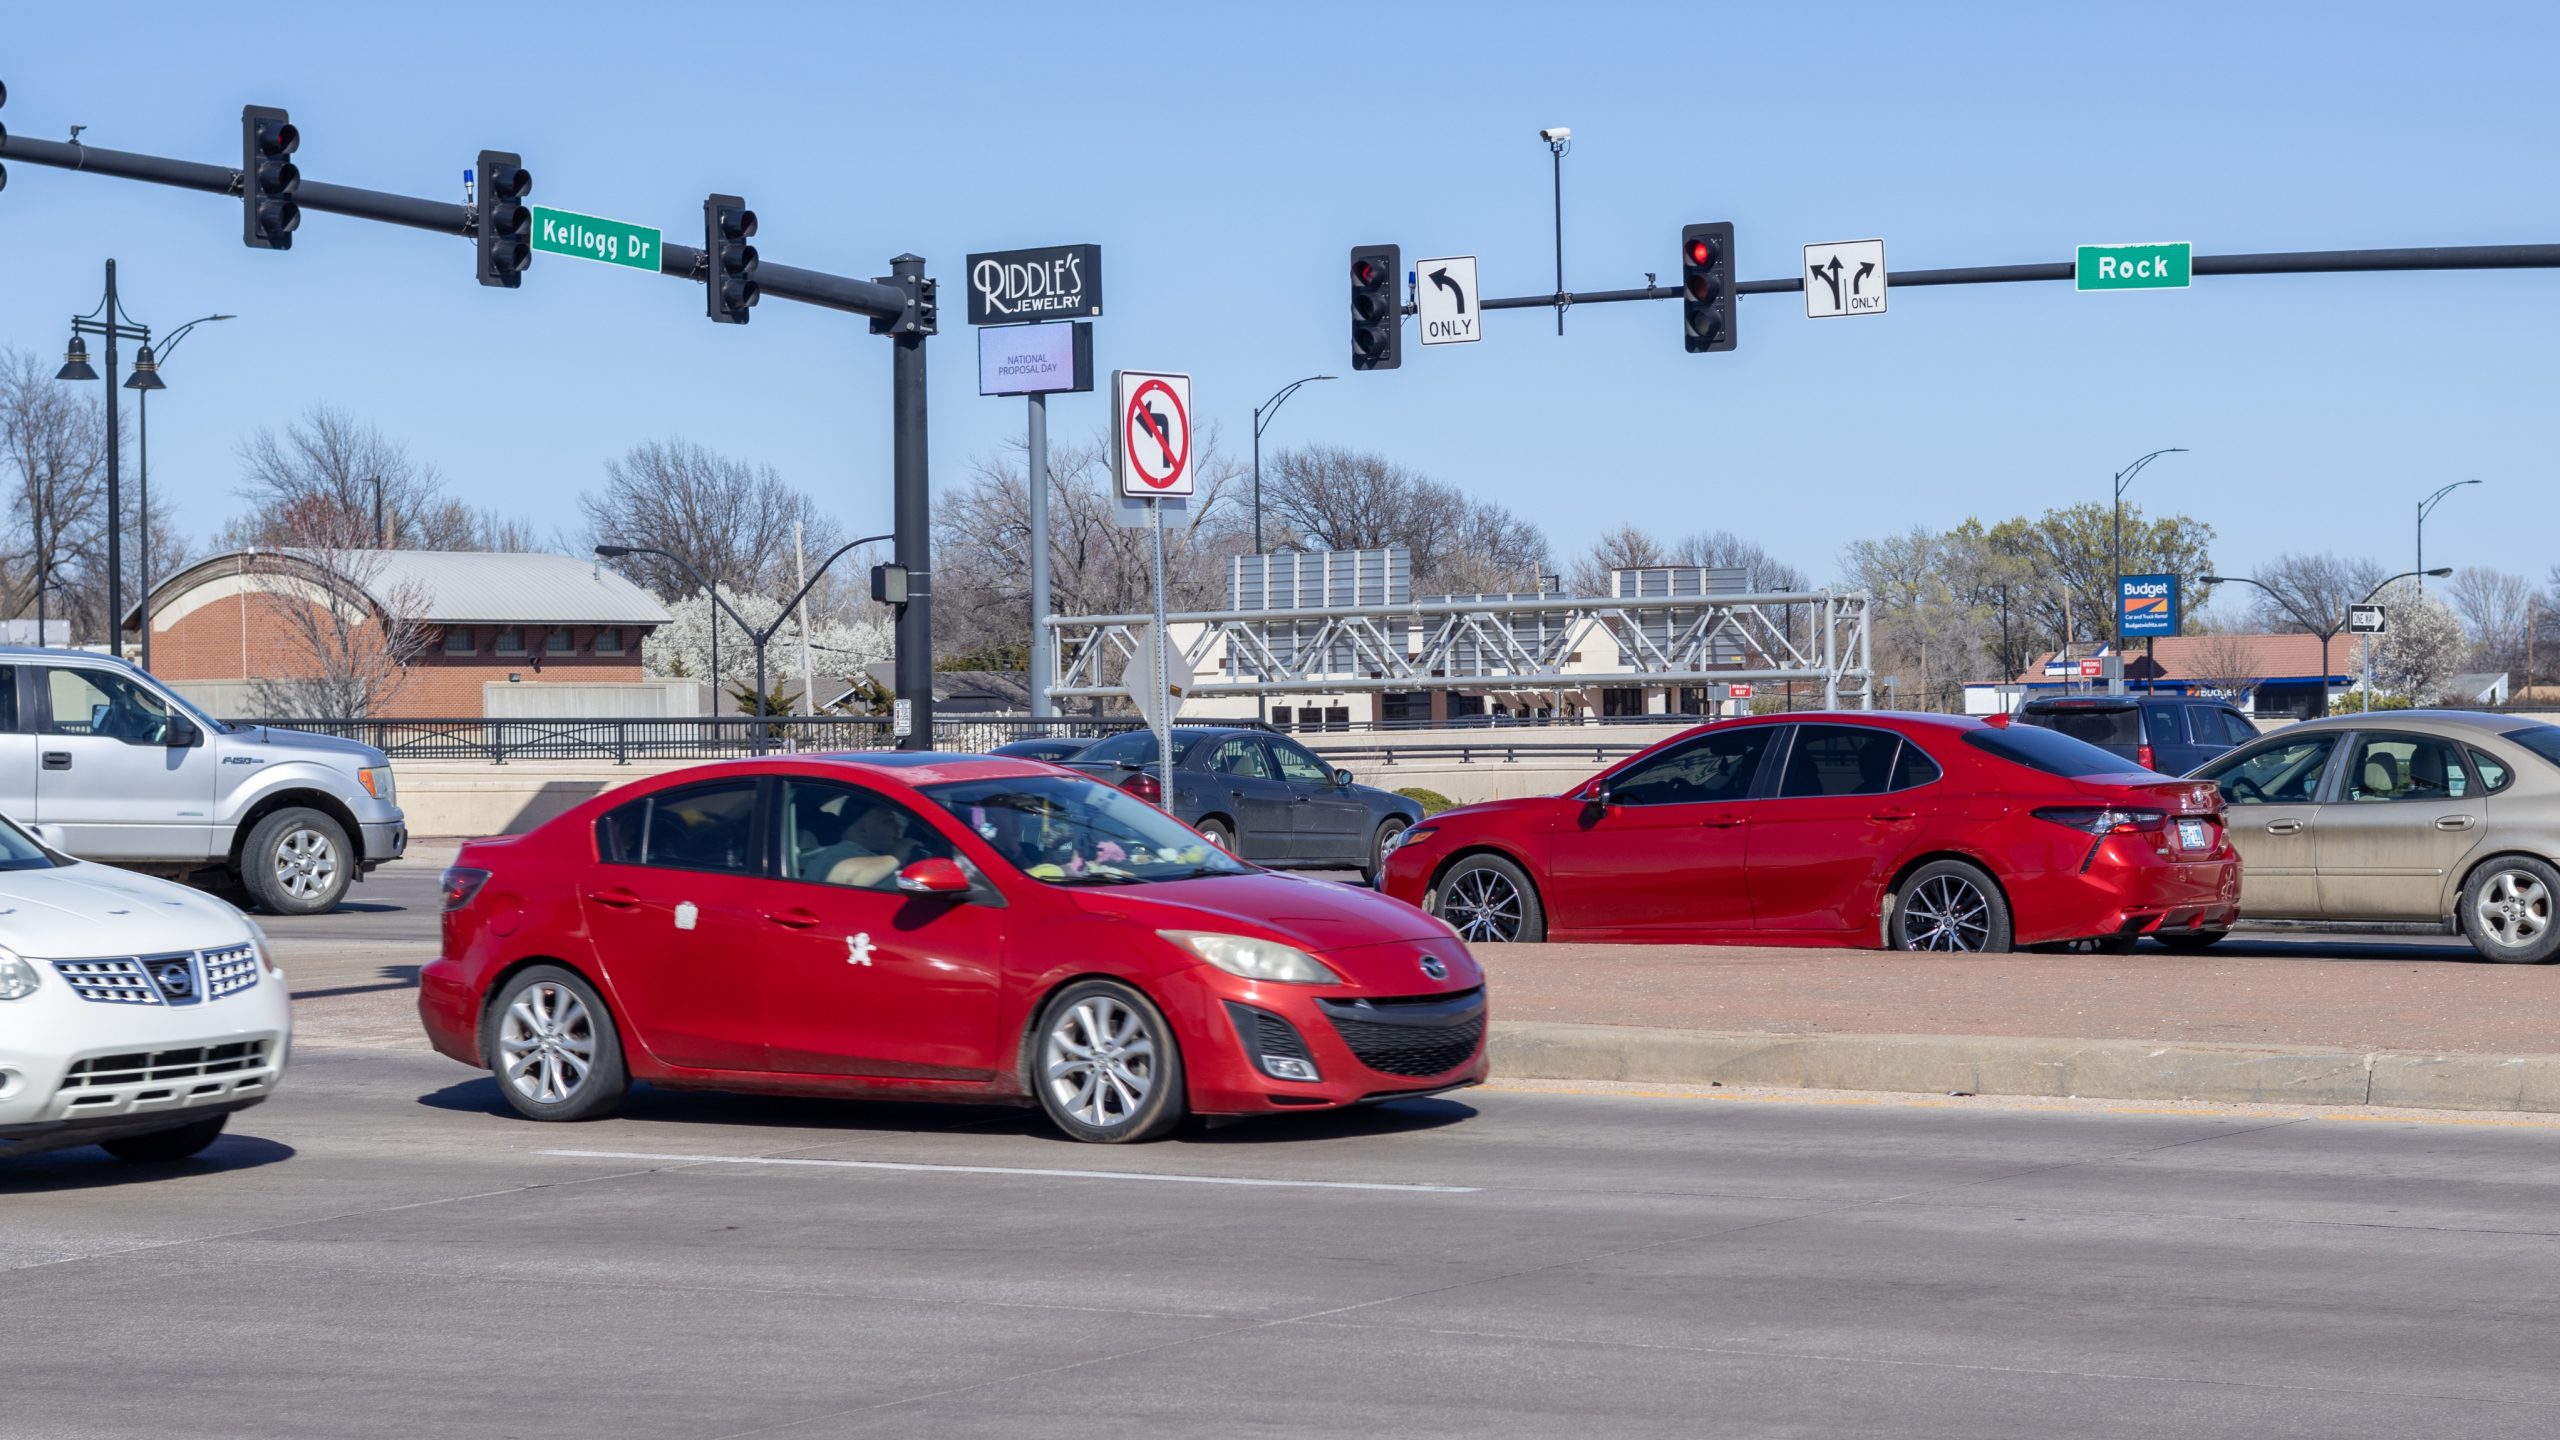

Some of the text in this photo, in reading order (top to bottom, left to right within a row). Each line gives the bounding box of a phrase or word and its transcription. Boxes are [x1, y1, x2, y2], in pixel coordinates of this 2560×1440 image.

[543, 218, 650, 260] Kellogg Dr
[2099, 255, 2169, 279] Rock
[973, 253, 1081, 315] RIDDLE'S
[1013, 295, 1081, 312] JEWELRY
[1851, 296, 1880, 309] ONLY
[1429, 319, 1472, 338] ONLY
[1007, 355, 1047, 365] NATIONAL
[998, 363, 1057, 376] PROPOSAL DAY
[2124, 582, 2168, 598] Budget
[2354, 612, 2375, 625] ONE WAY
